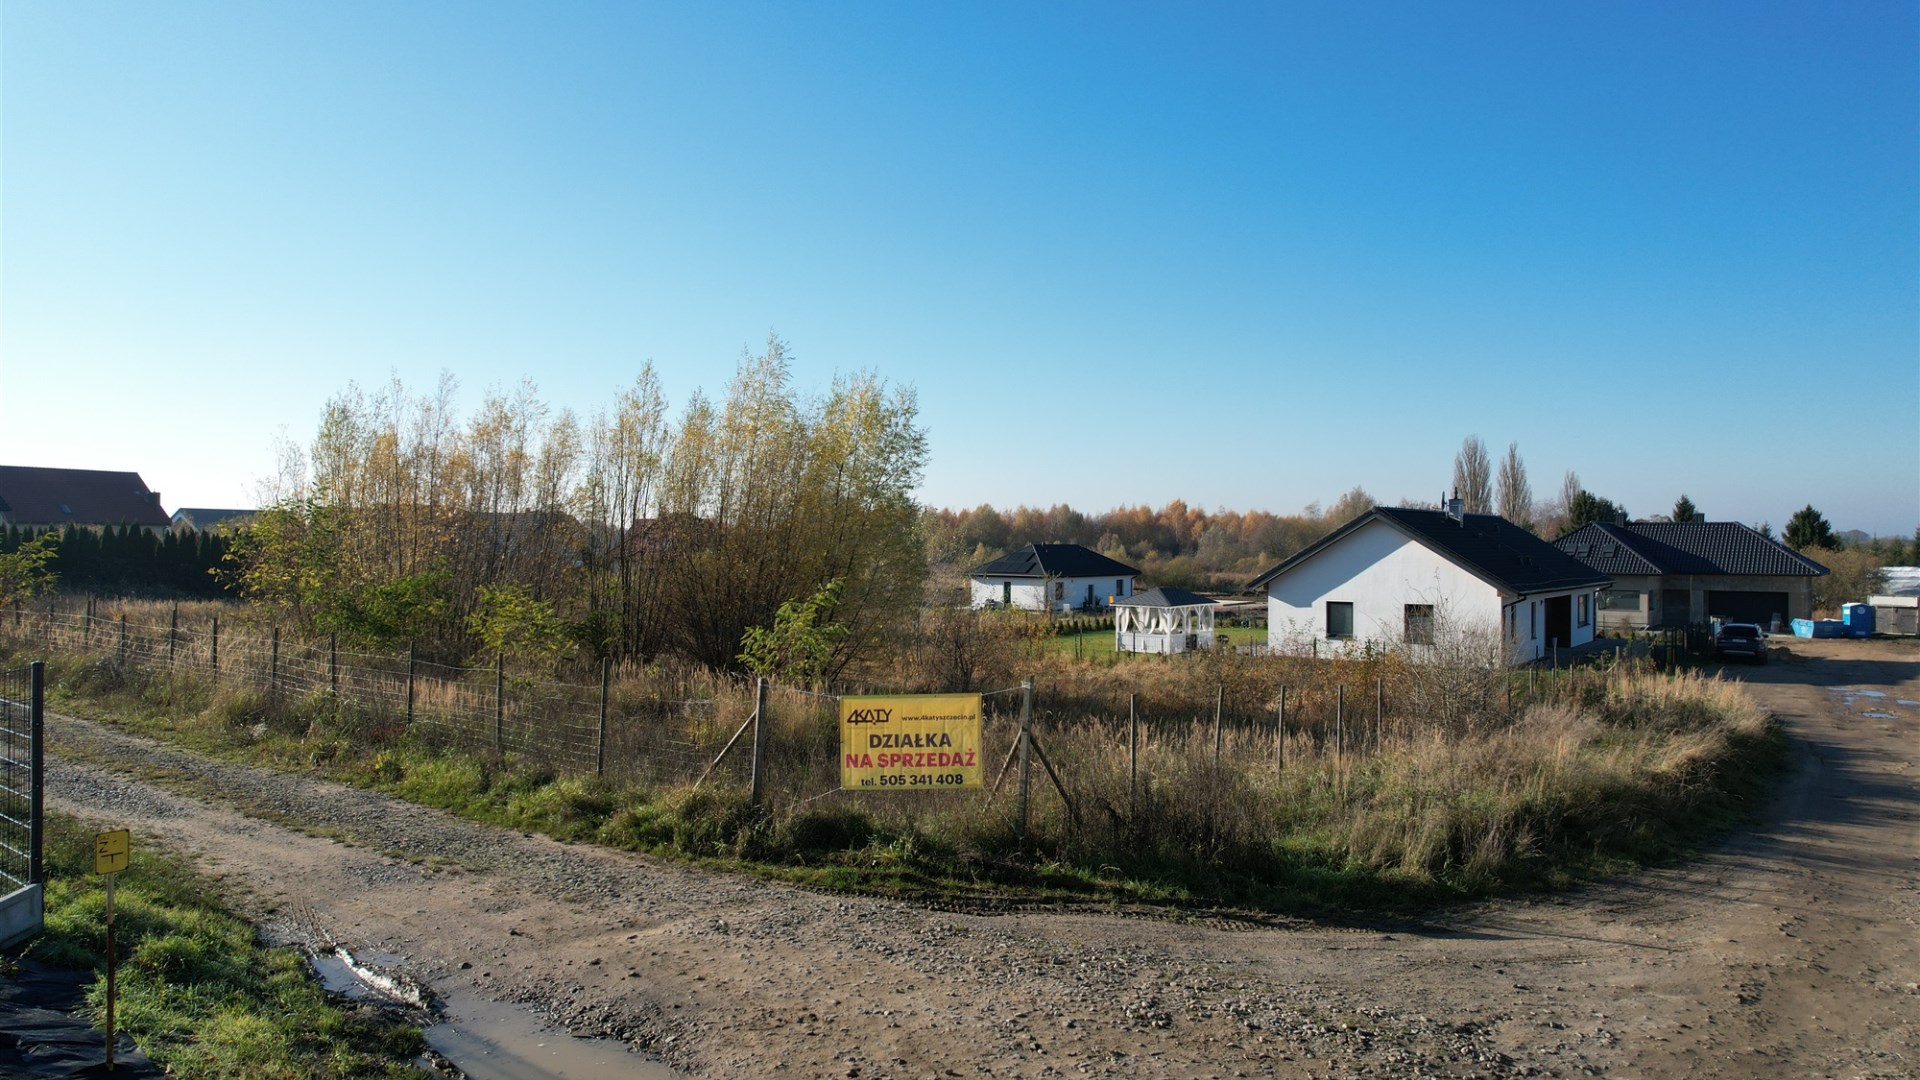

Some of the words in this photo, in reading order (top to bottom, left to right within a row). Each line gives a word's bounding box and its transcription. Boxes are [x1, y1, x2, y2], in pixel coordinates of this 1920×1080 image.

[902, 714, 976, 722] www.4katyszczecin.pl
[870, 733, 952, 748] DZIAŁKA
[845, 753, 873, 768] NA
[877, 748, 976, 768] SPRZEDAŻ
[861, 777, 877, 787] tel.
[880, 775, 906, 786] 505
[910, 774, 932, 785] 341
[936, 774, 964, 785] 408
